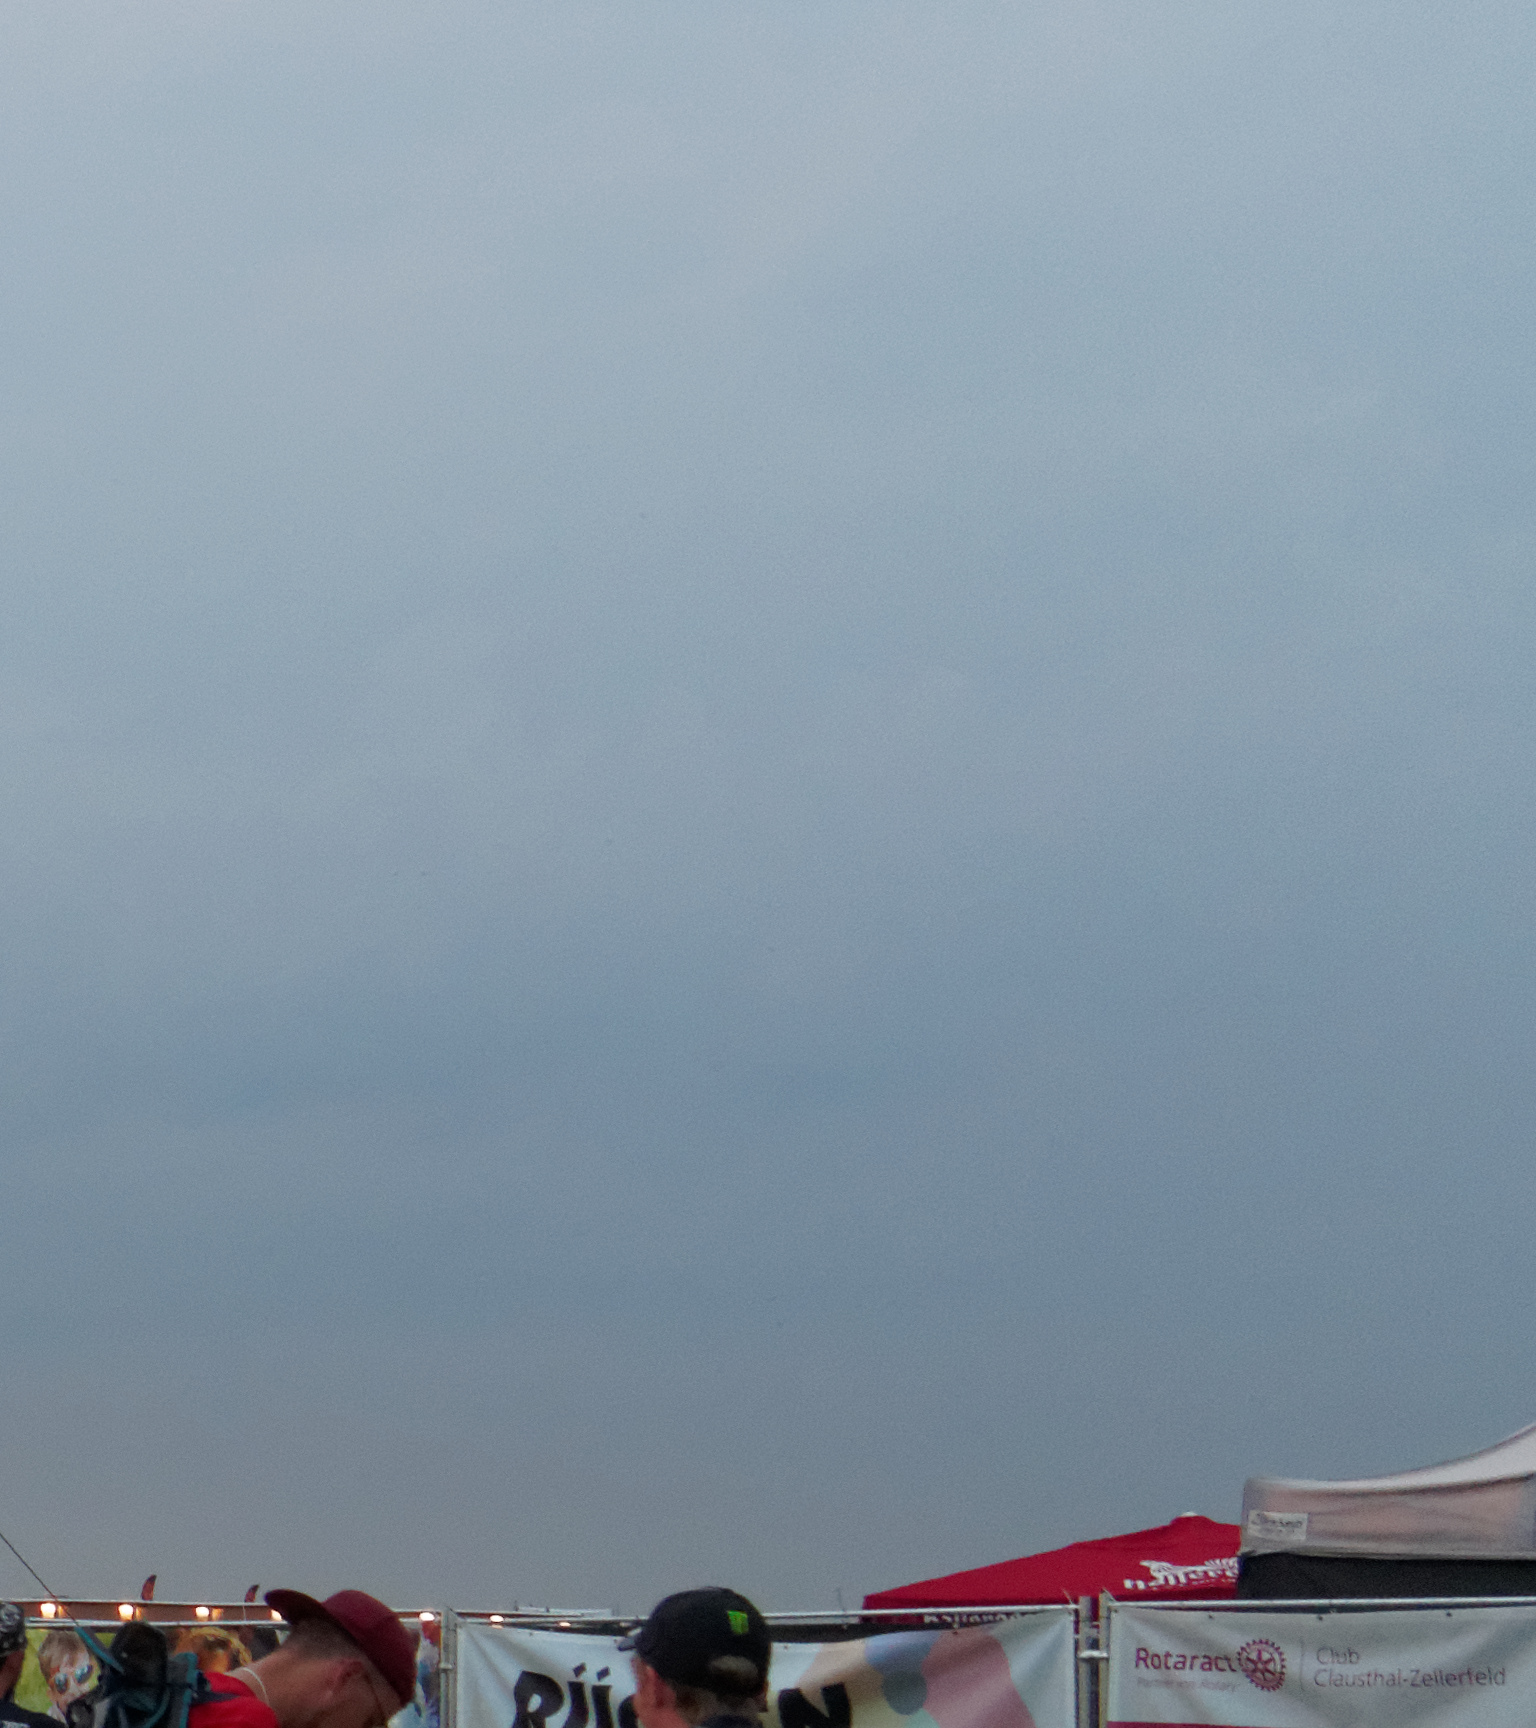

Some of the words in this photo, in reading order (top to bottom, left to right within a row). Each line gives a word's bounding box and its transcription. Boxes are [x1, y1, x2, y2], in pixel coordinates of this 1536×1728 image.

[1135, 1647, 1238, 1673] Rotaract
[1316, 1646, 1361, 1665] Club
[1313, 1667, 1507, 1688] Clausthal-Zellerfeld
